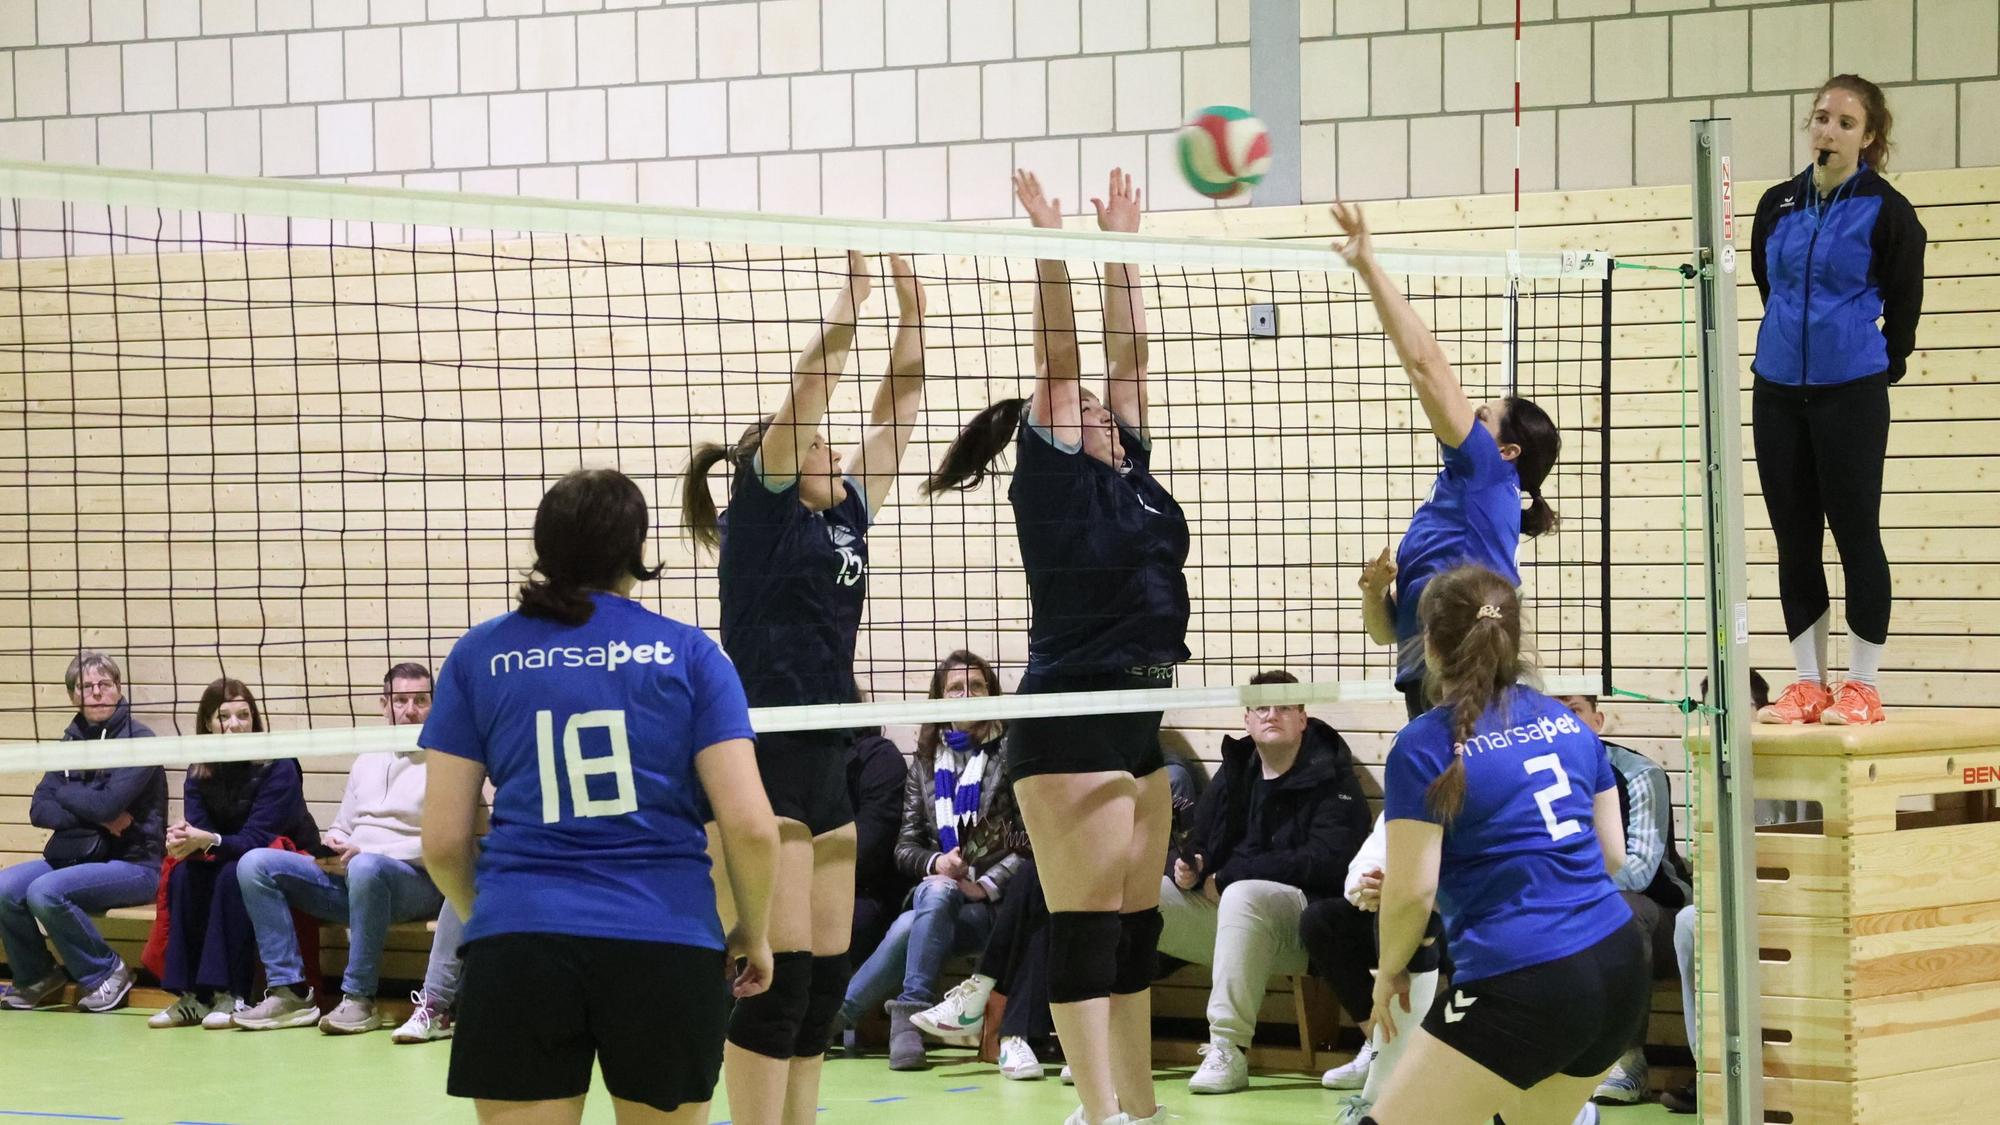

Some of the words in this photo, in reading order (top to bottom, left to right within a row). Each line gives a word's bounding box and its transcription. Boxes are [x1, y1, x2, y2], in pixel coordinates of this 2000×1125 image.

[490, 640, 675, 676] marsapet
[536, 709, 638, 824] 18
[1463, 713, 1581, 757] marsapet
[1523, 752, 1582, 842] 2
